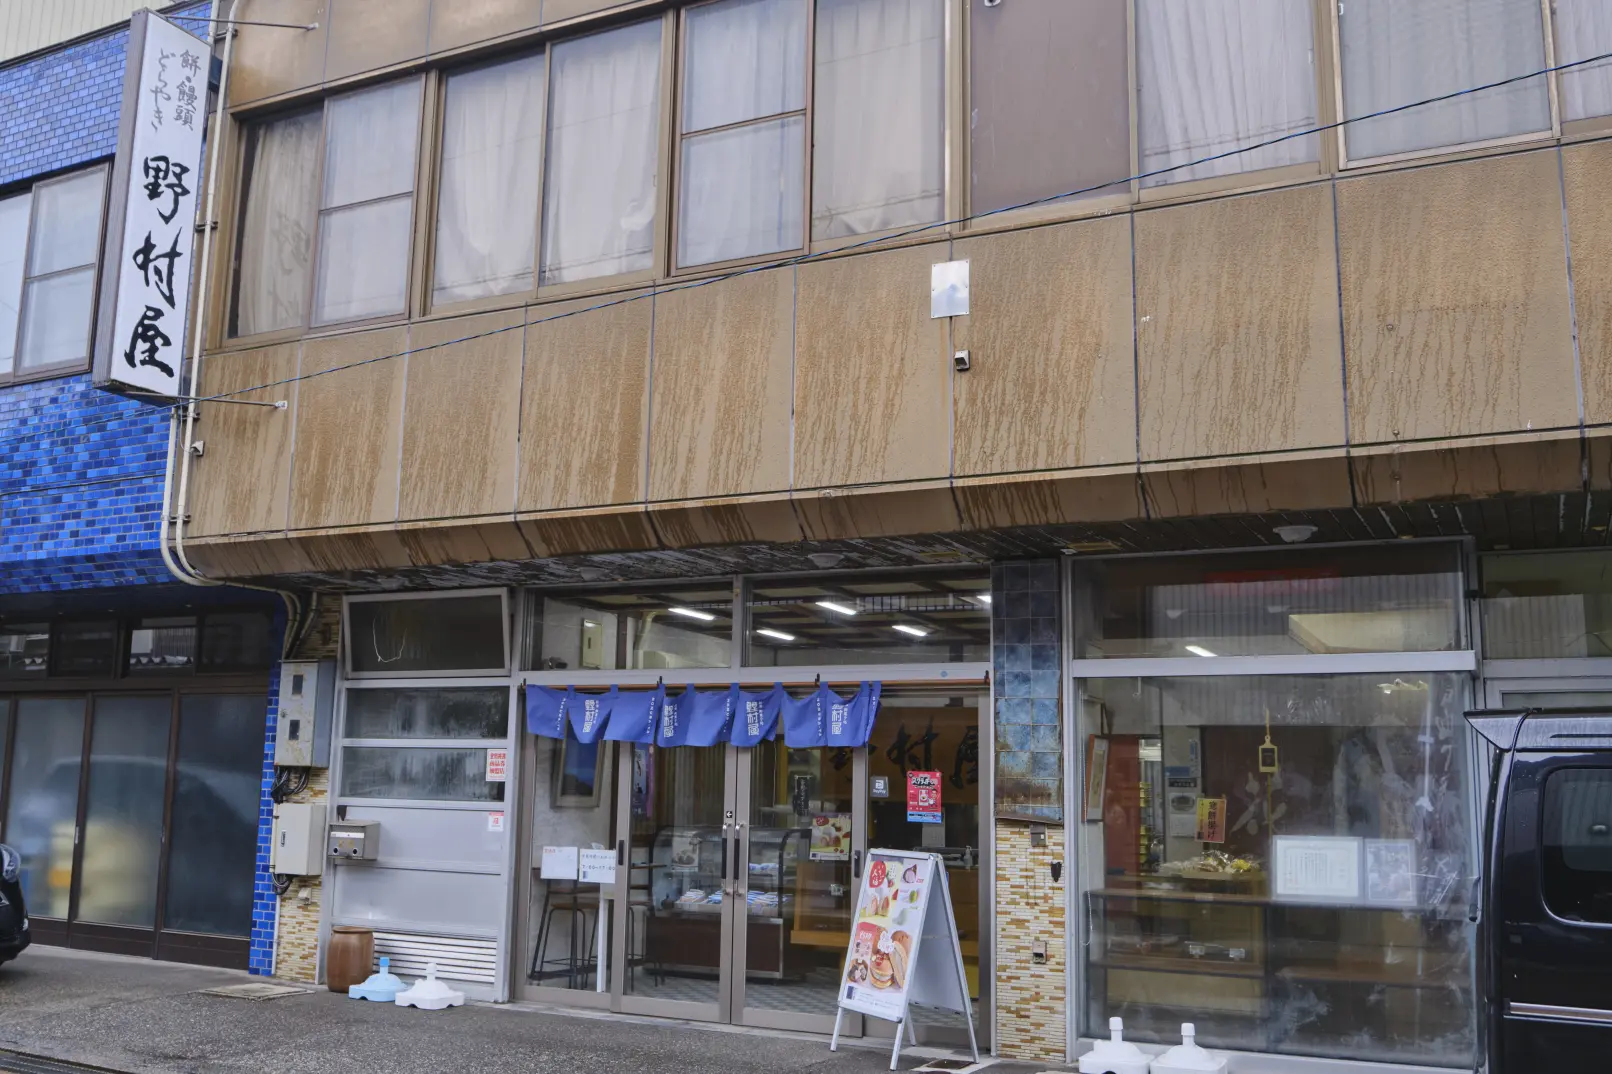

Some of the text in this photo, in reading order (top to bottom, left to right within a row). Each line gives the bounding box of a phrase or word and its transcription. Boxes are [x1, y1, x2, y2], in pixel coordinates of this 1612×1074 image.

[149, 47, 176, 132] どらやき
[124, 154, 191, 379] 野村屋
[746, 701, 760, 736] 野村屋
